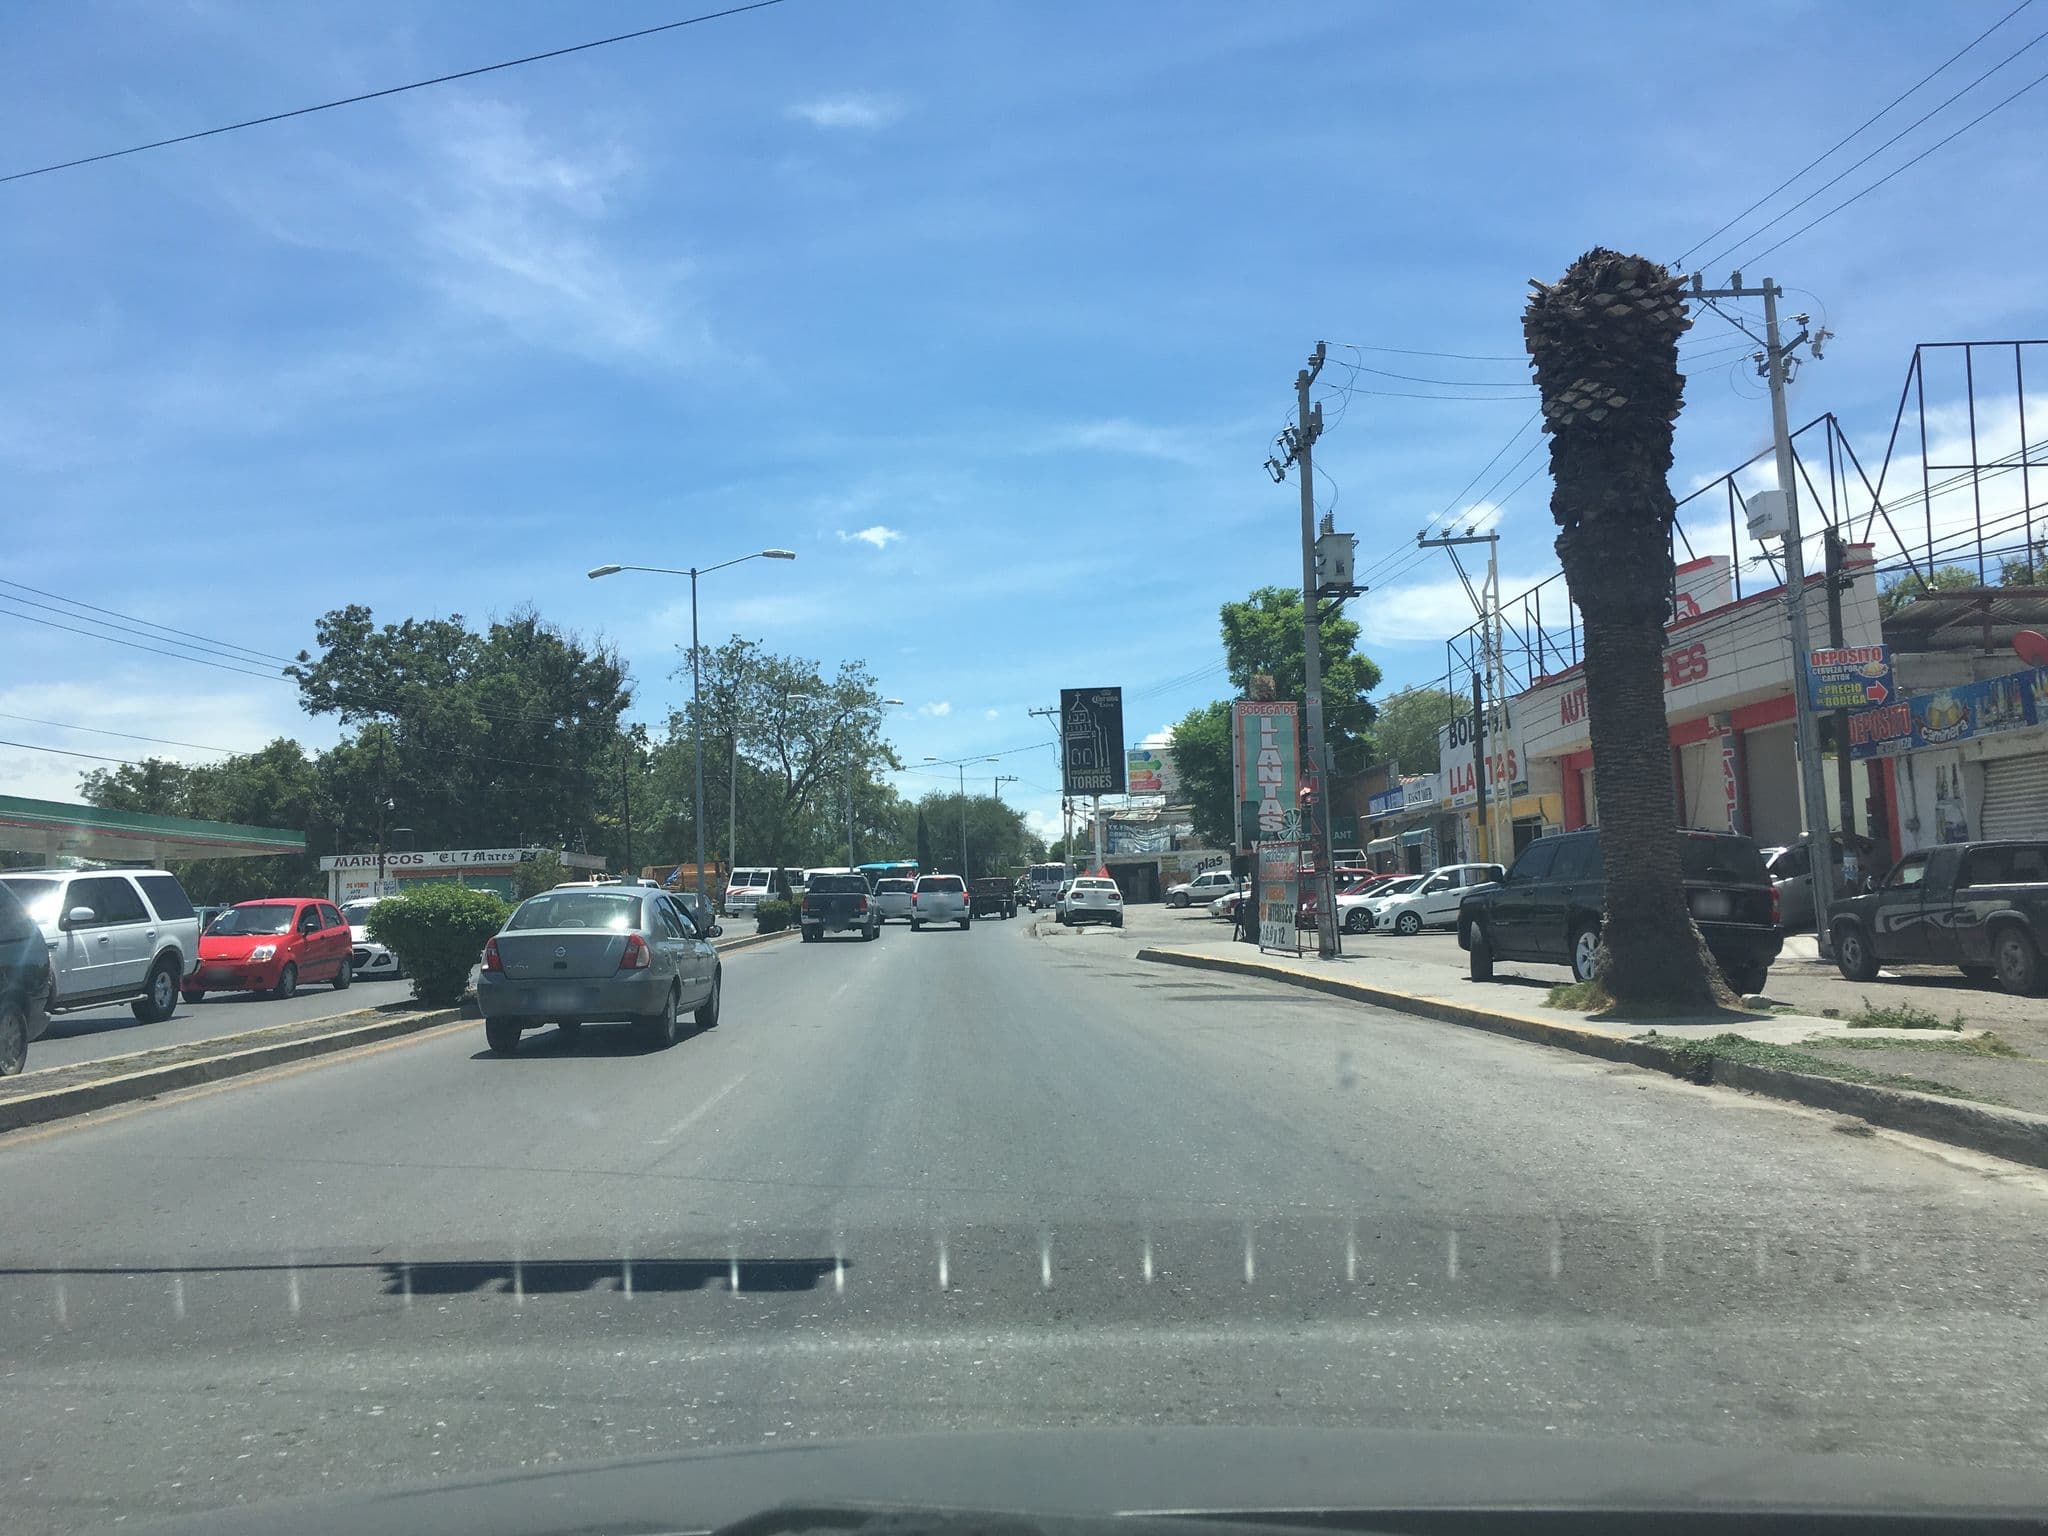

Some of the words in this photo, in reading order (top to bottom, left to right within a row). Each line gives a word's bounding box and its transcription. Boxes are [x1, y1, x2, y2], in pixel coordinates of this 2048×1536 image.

[1811, 647, 1882, 666] DEPOSITO
[1824, 683, 1862, 695] PRECIO
[1560, 687, 1586, 725] AUT
[1824, 694, 1866, 706] BODEGA
[1239, 704, 1280, 715] BODEGA
[1283, 703, 1298, 715] DE
[1848, 702, 1912, 746] DEPOSITO
[1257, 717, 1284, 832] LLANTAS
[1449, 749, 1518, 795] LLATAS
[1071, 775, 1112, 789] TORRES
[334, 854, 424, 868] MARISCOS
